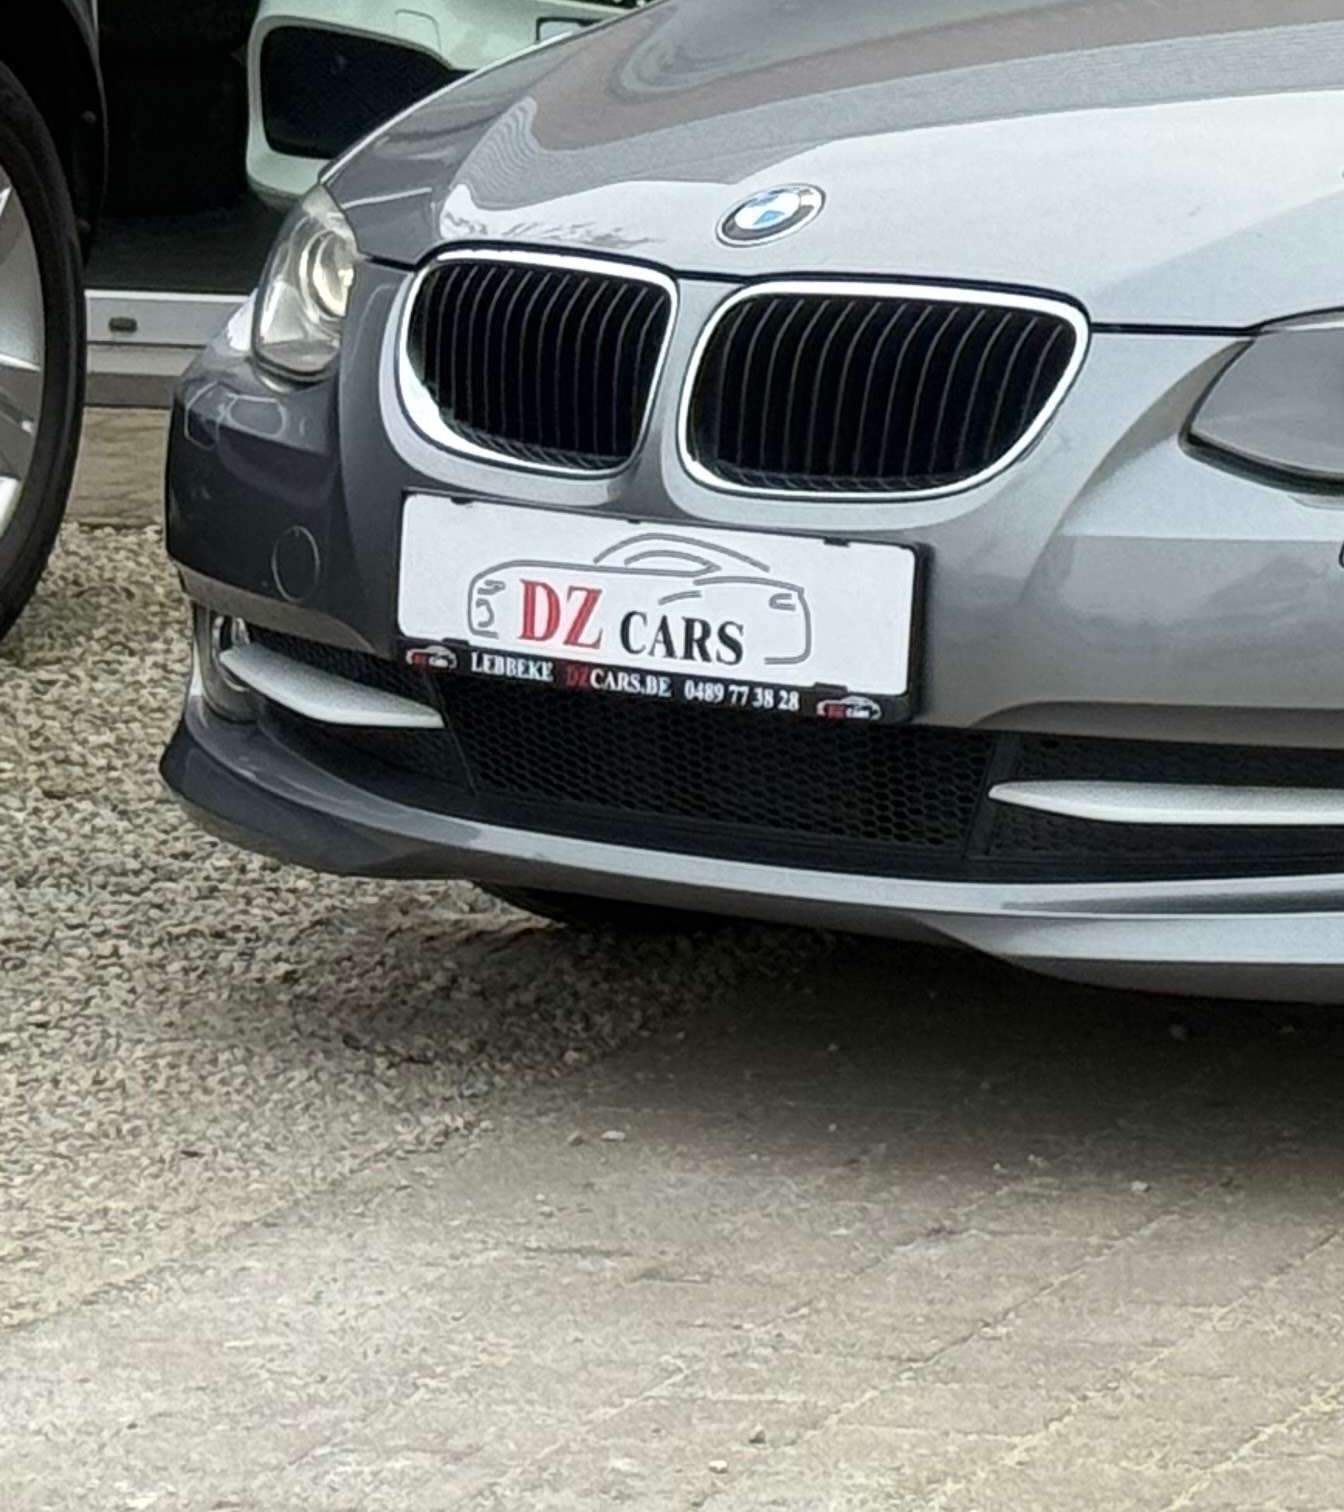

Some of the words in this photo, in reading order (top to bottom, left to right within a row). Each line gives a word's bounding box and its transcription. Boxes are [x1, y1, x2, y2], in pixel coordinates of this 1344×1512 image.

[517, 577, 604, 650] DZ
[619, 610, 745, 666] CARS
[470, 650, 554, 683] LEBBEKE
[684, 679, 725, 704] 0489
[727, 684, 750, 707] 77
[751, 686, 775, 710] 38
[777, 690, 800, 711] 28
